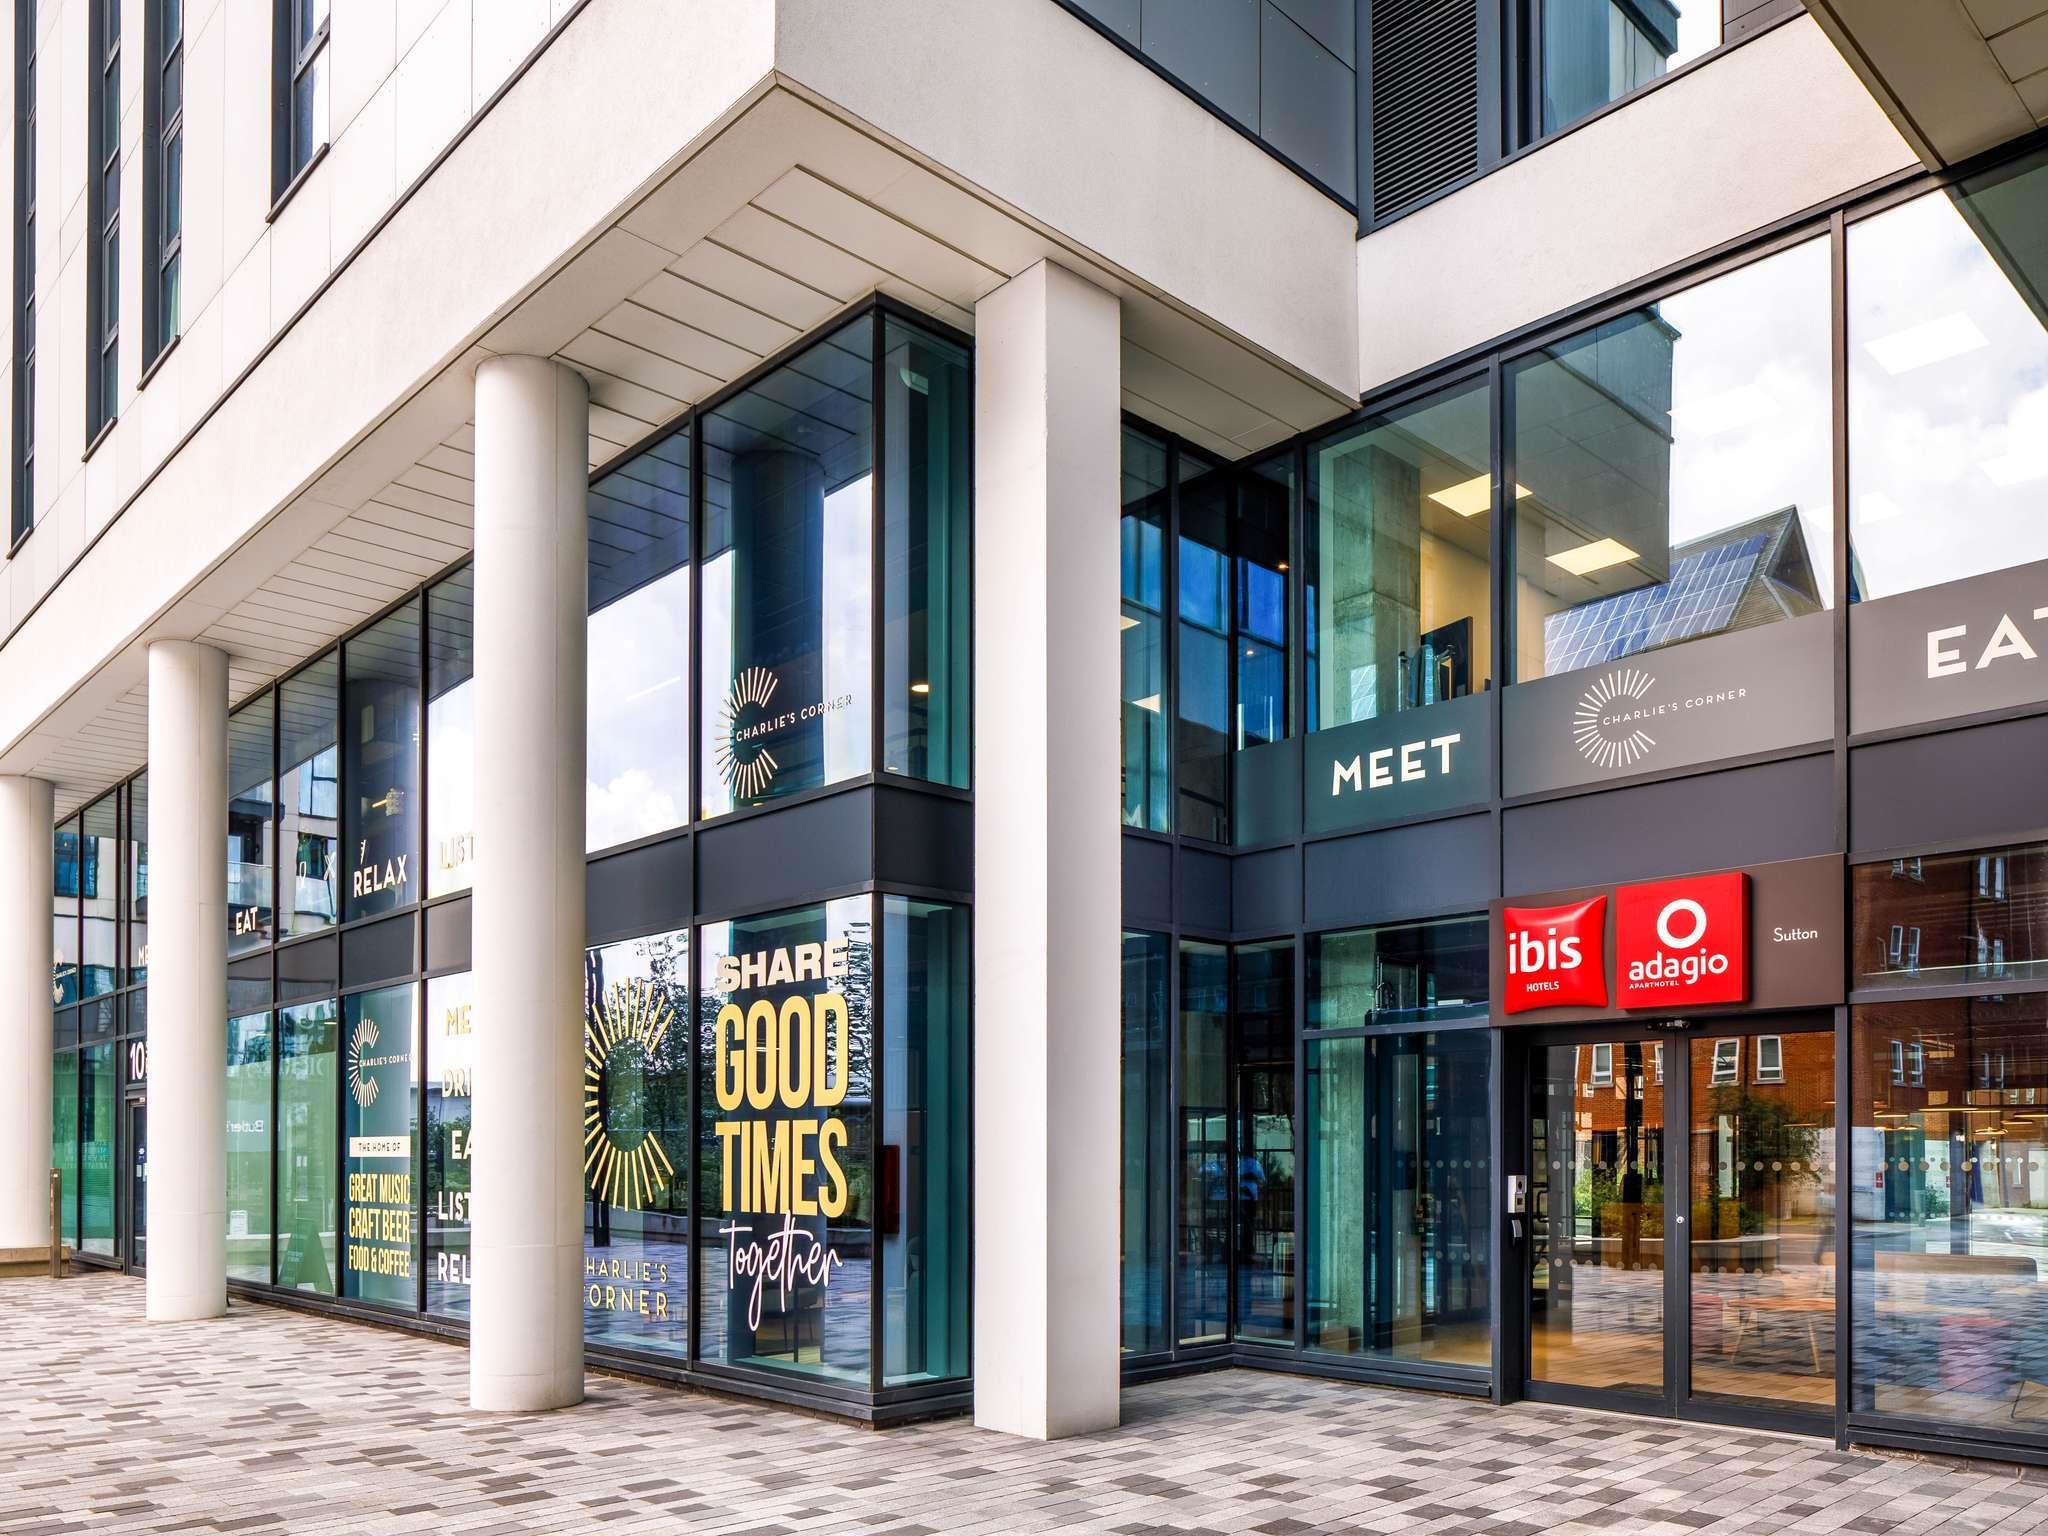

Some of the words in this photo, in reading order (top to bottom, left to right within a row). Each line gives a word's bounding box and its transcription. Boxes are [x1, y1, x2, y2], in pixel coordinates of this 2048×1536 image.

[736, 711, 796, 742] CHARLIE'S
[800, 693, 853, 721] CORNER
[1603, 702, 1679, 727] CHARLIE'S
[1685, 687, 1747, 709] CORNER
[1332, 733, 1461, 797] MEET
[353, 854, 407, 898] RELAX
[235, 906, 258, 936] EAT
[1773, 927, 1818, 943] Sutton
[716, 938, 849, 993] SHARE
[1508, 928, 1583, 975] ibis
[1628, 948, 1729, 985] adagio
[1526, 980, 1560, 993] HOTELS
[1629, 979, 1680, 990] APARTHOTEL
[130, 1041, 147, 1081] 10
[359, 1055, 388, 1068] CHARLIE'S
[715, 993, 849, 1111] GOOD
[358, 1142, 371, 1153] THE
[373, 1141, 391, 1152] HOME
[392, 1141, 401, 1152] OF
[715, 1117, 848, 1218] TIMES
[349, 1173, 378, 1202] GREAT
[379, 1173, 411, 1205] MUSIC
[349, 1207, 381, 1240] CRAFT
[382, 1208, 410, 1244] BEER
[348, 1244, 369, 1272] FOOD
[371, 1249, 377, 1273] &
[378, 1249, 410, 1278] COFFEE
[438, 1251, 472, 1286] REL
[719, 1209, 843, 1332] together
[584, 1284, 669, 1318] ORNER
